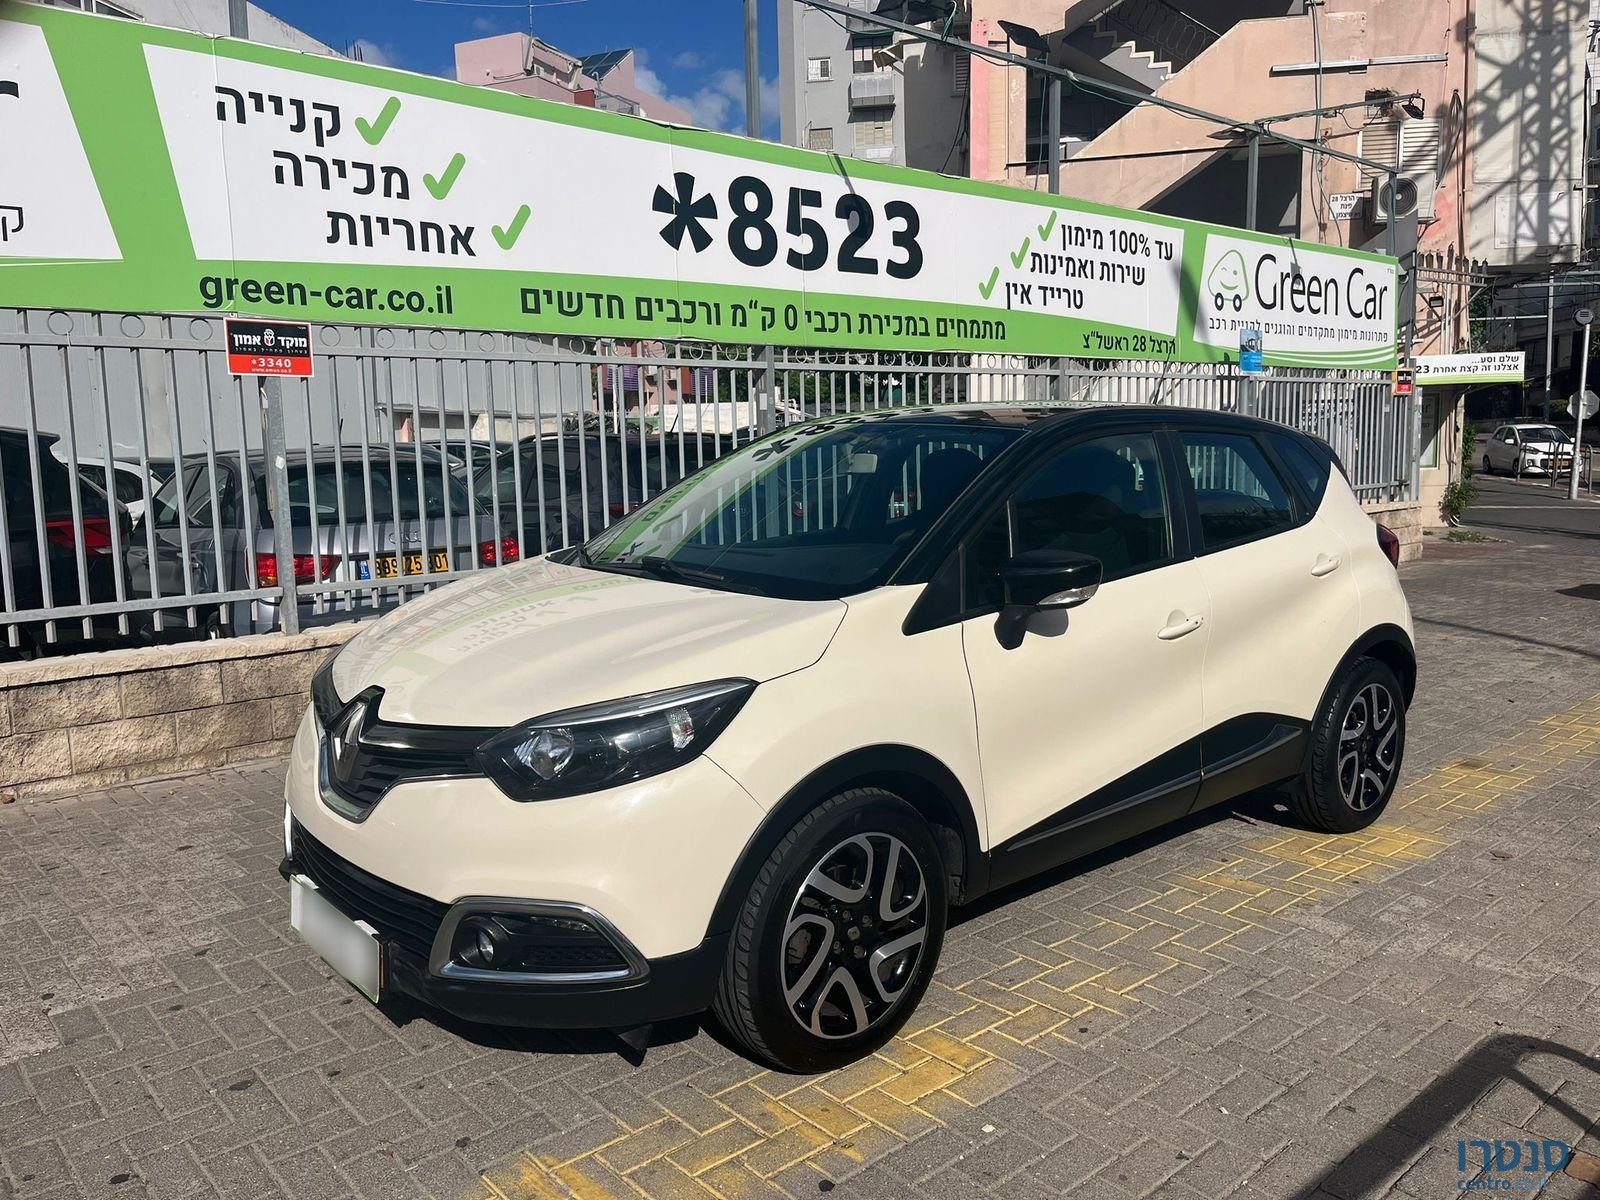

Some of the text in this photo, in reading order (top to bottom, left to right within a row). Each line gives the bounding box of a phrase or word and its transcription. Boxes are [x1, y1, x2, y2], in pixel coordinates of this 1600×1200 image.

[215, 85, 341, 147] קנייה
[273, 150, 410, 200] מכירה
[326, 210, 477, 256] אחריות
[1061, 224, 1173, 261] עד 100% מימון
[1030, 252, 1145, 286] שירות ואמינות
[199, 274, 453, 315] green-car.co.il
[1005, 282, 1083, 310] טרייד אין
[1254, 253, 1388, 321] Green Car
[520, 288, 625, 320] חדשים
[635, 296, 721, 326] ורכבים
[784, 304, 798, 331] 0
[805, 310, 852, 333] רכבי
[858, 312, 930, 337] במכירת
[936, 317, 1006, 340] מתמחים
[1209, 317, 1227, 330] רכב
[1264, 322, 1295, 336] והוגנים
[233, 334, 307, 349] מוקד אמון
[1132, 335, 1146, 352] 28
[1299, 325, 1335, 341] מתקדמים
[1337, 328, 1358, 342] מימון
[1360, 330, 1388, 342] פתרונות
[1149, 336, 1176, 354] הרצל
[1432, 366, 1458, 374] אחרת
[1459, 365, 1479, 373] קצת
[1494, 363, 1520, 371] אצלנו
[1499, 355, 1520, 363] שלם
